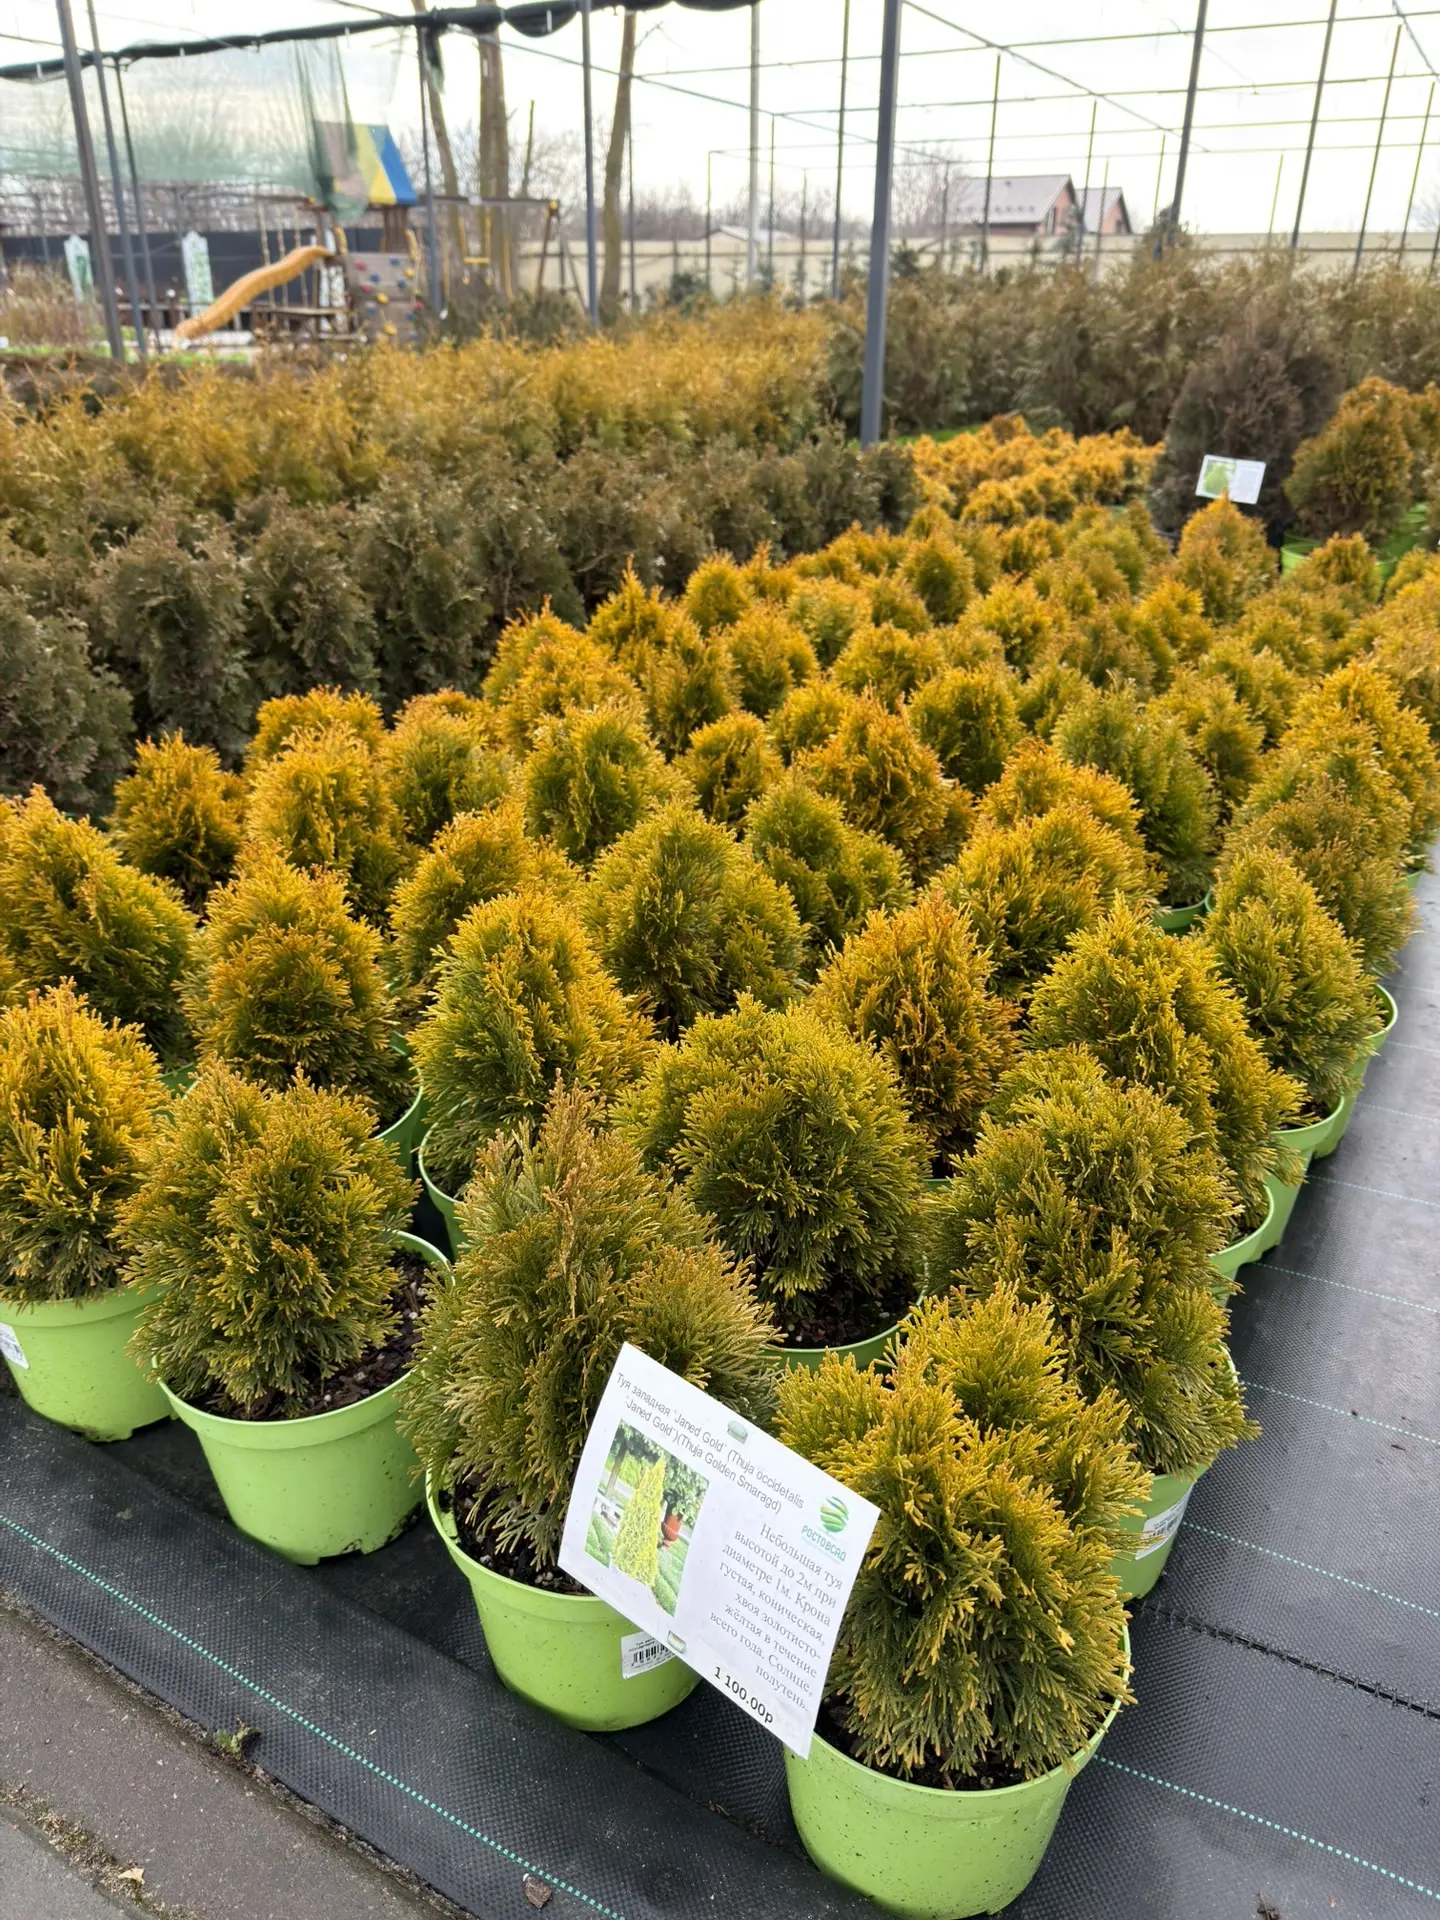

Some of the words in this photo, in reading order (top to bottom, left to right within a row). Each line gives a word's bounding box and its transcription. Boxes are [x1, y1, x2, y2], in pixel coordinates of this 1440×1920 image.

[616, 1372, 631, 1389] Туя
[632, 1385, 671, 1417] западная
[727, 1449, 755, 1475] (Thuja
[756, 1470, 805, 1509] occidetalis
[704, 1452, 737, 1481] Golden
[737, 1474, 782, 1515] Smaragd)
[734, 1530, 780, 1568] высотой
[780, 1563, 795, 1579] до
[796, 1571, 813, 1592] 2м
[814, 1586, 837, 1609] при
[760, 1524, 822, 1576] Небольшая
[823, 1570, 843, 1590] туя
[801, 1525, 847, 1562] РОСТОВСАД
[719, 1561, 756, 1596] густая,
[758, 1589, 825, 1647] коническая,
[722, 1543, 773, 1584] диаметре
[775, 1578, 792, 1600] 1м.
[794, 1592, 831, 1627] Крона
[710, 1612, 739, 1638] всего
[739, 1633, 765, 1660] года.
[768, 1653, 814, 1697] Солнце,
[724, 1604, 763, 1637] жёлтая
[764, 1634, 772, 1644] в
[773, 1639, 817, 1678] течение
[735, 1592, 760, 1617] хвоя
[762, 1612, 822, 1660] золотисто-
[714, 1666, 721, 1680] 1
[724, 1675, 774, 1723] 100.00р
[755, 1664, 809, 1712] полутень.
